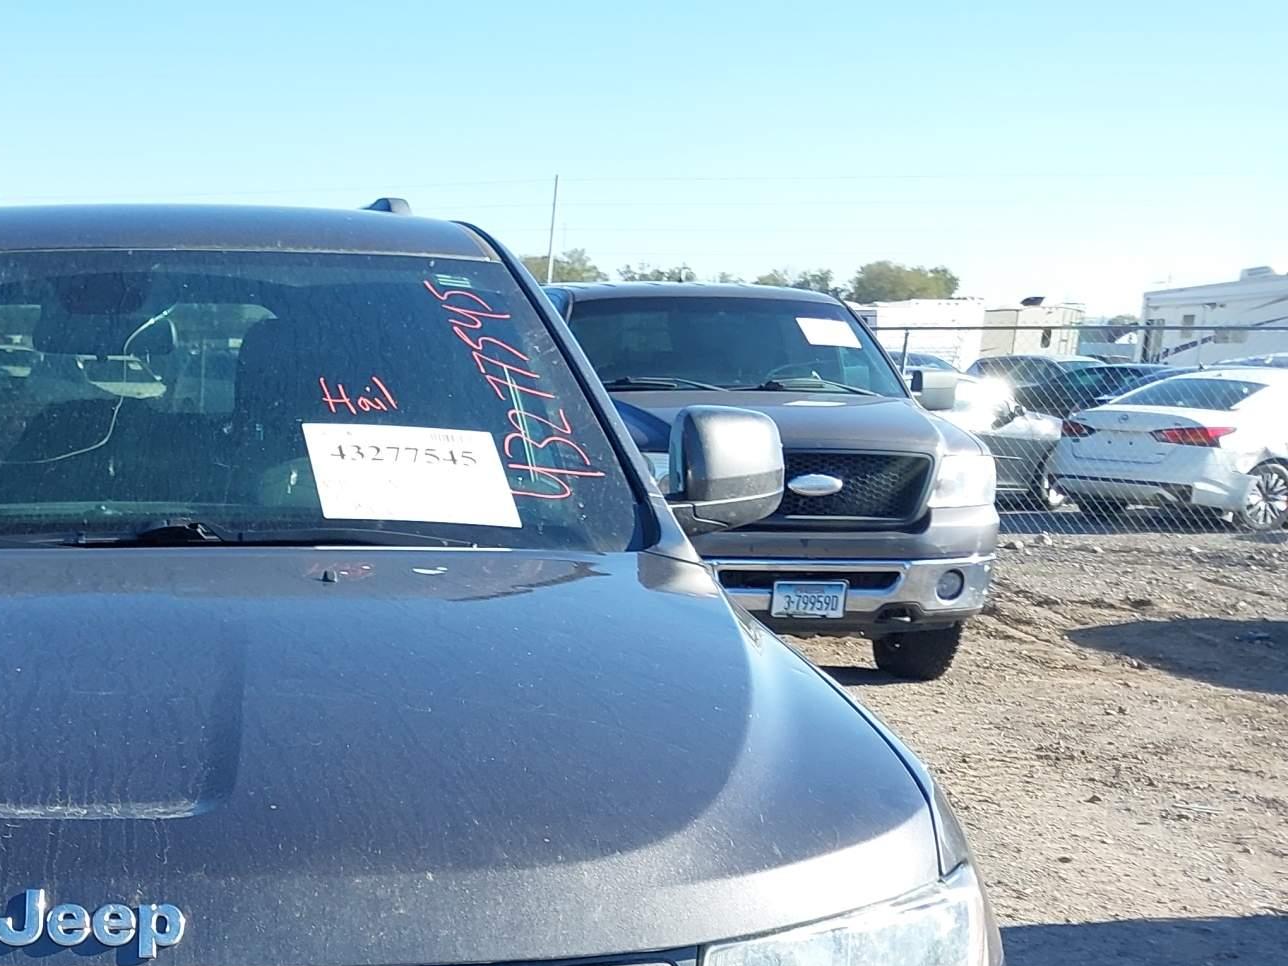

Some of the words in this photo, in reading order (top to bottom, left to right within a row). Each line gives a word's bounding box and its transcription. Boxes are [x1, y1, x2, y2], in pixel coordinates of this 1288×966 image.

[319, 376, 398, 415] Hail
[424, 280, 606, 498] 43277545
[330, 444, 478, 466] 43277545
